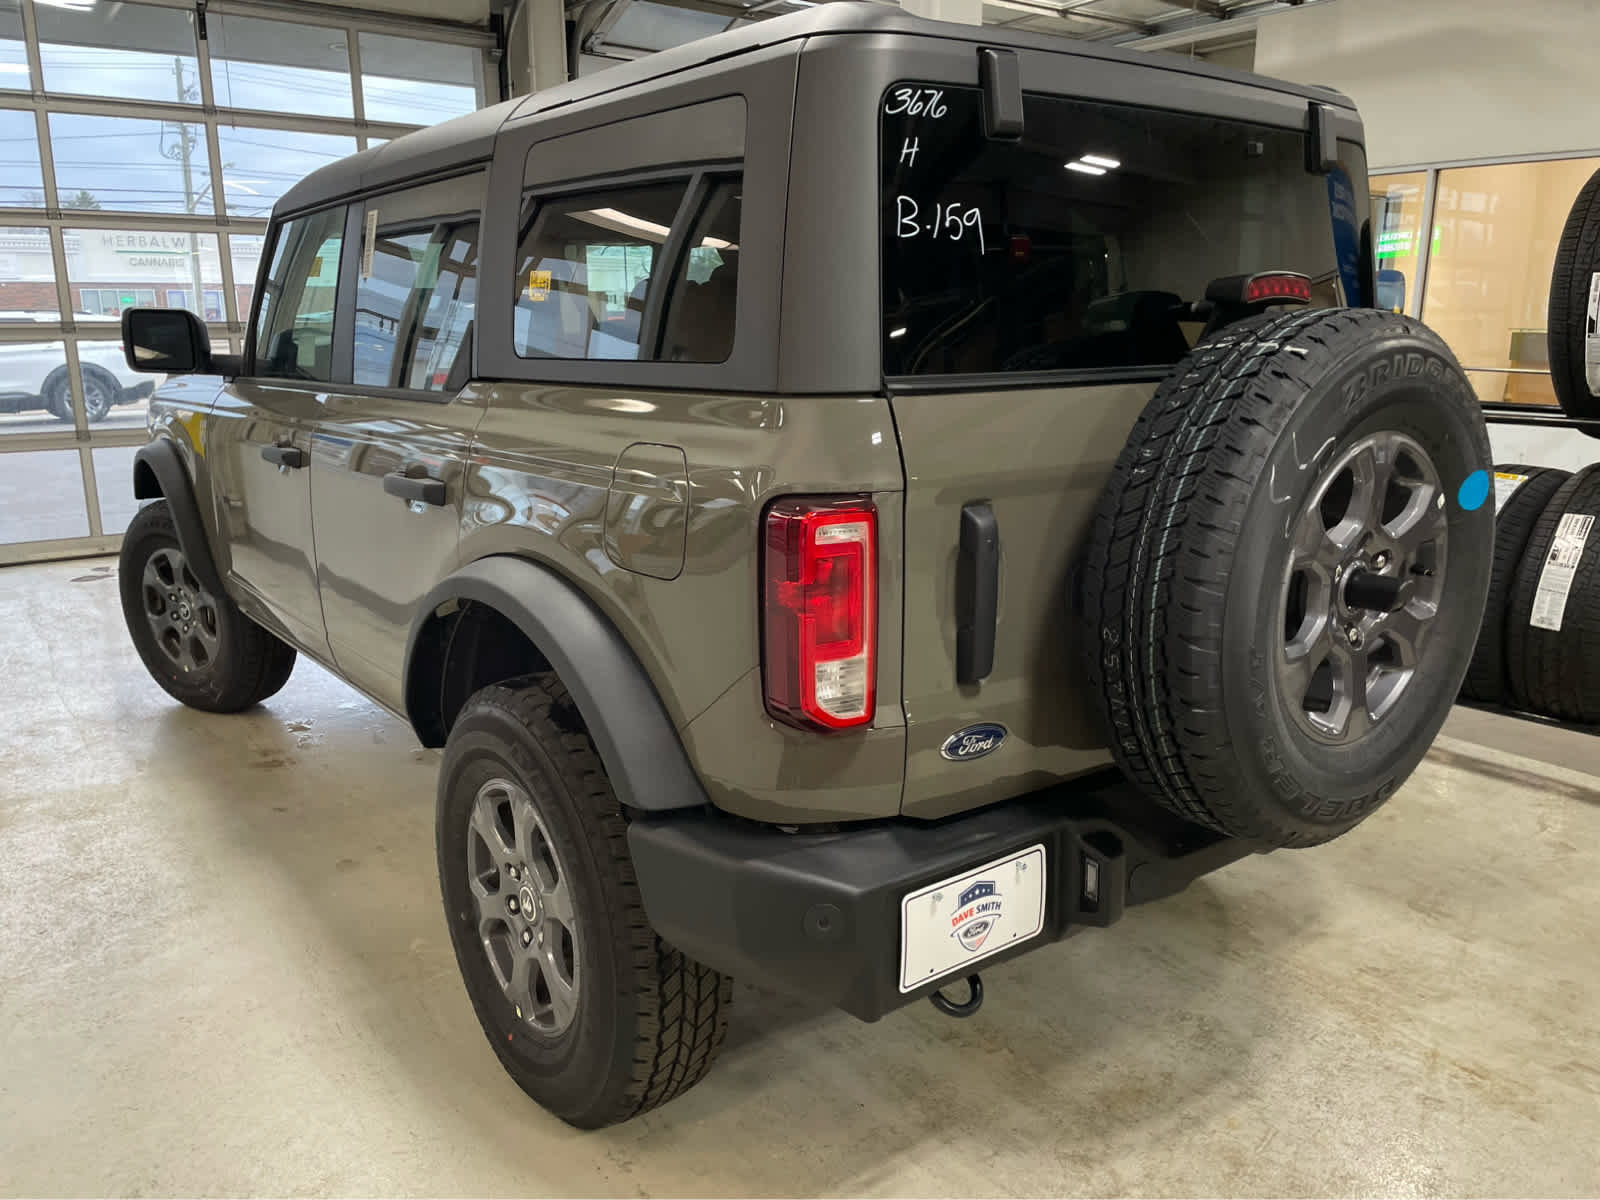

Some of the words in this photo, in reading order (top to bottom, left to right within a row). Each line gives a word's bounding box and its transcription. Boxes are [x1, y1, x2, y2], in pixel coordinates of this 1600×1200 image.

[885, 88, 948, 119] 3676
[899, 136, 919, 167] H
[129, 256, 185, 268] CANNABIS
[951, 906, 975, 927] DAVE
[975, 899, 1003, 914] SMITH
